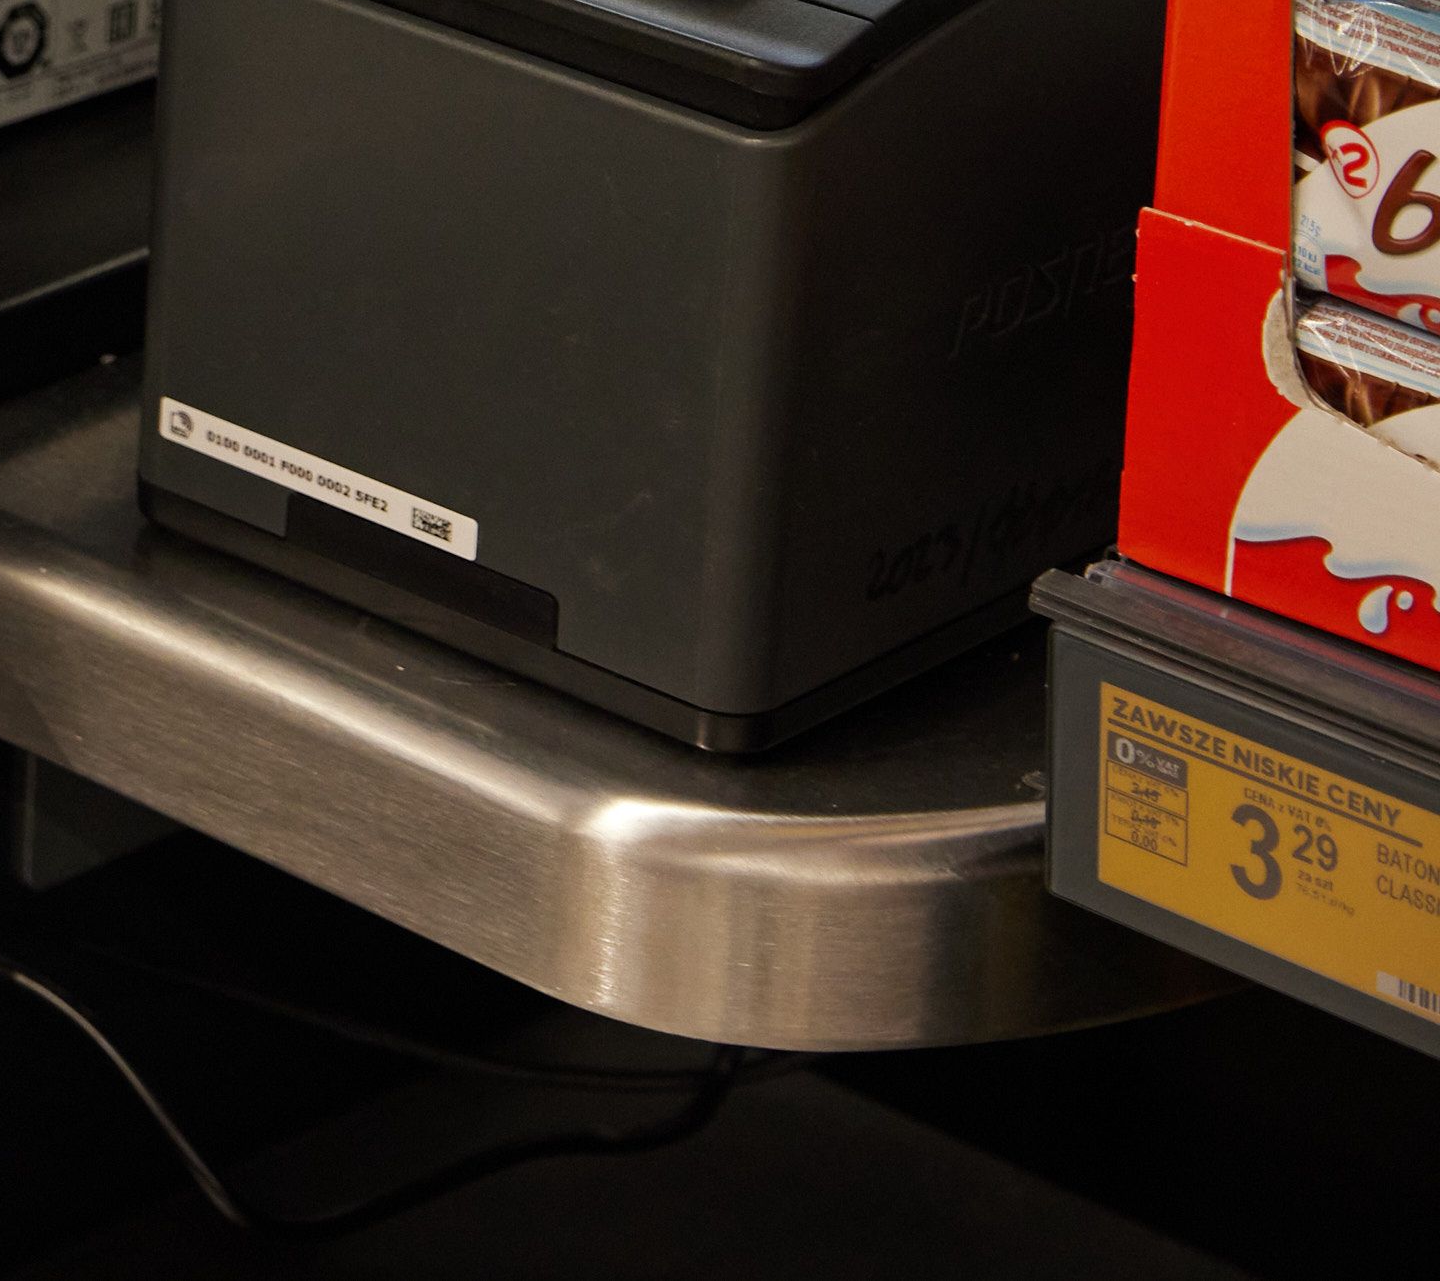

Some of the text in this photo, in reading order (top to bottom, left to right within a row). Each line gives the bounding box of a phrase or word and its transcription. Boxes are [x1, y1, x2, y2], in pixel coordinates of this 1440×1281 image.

[1112, 695, 1402, 829] ZAWSZE NISKIE CENY
[1229, 803, 1339, 902] 3 29
[1376, 842, 1440, 886] BATON
